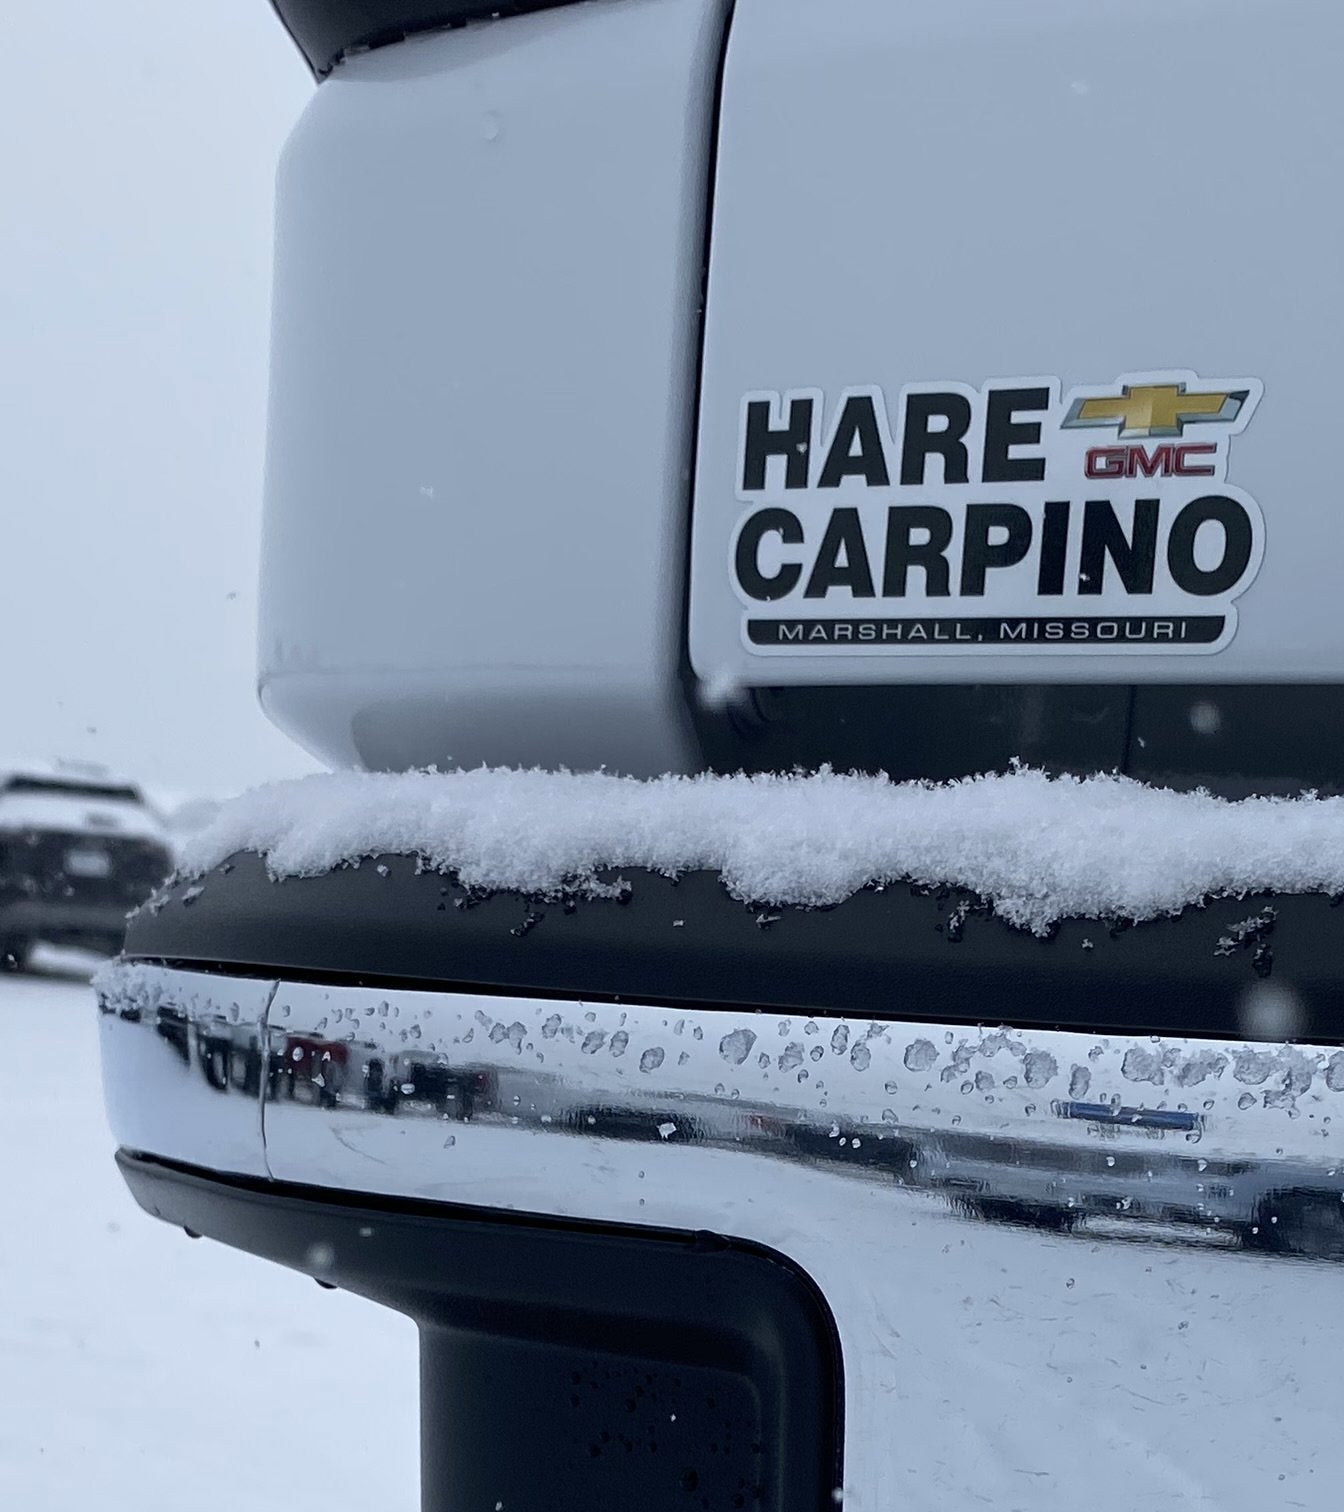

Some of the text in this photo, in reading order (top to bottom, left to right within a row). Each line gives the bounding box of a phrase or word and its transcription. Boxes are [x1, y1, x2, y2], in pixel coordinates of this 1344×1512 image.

[743, 387, 1050, 490] HARE
[1084, 442, 1218, 480] GMC
[735, 495, 1253, 601] CARPINO
[777, 620, 1187, 642] MARSHALL, MISSOURI
